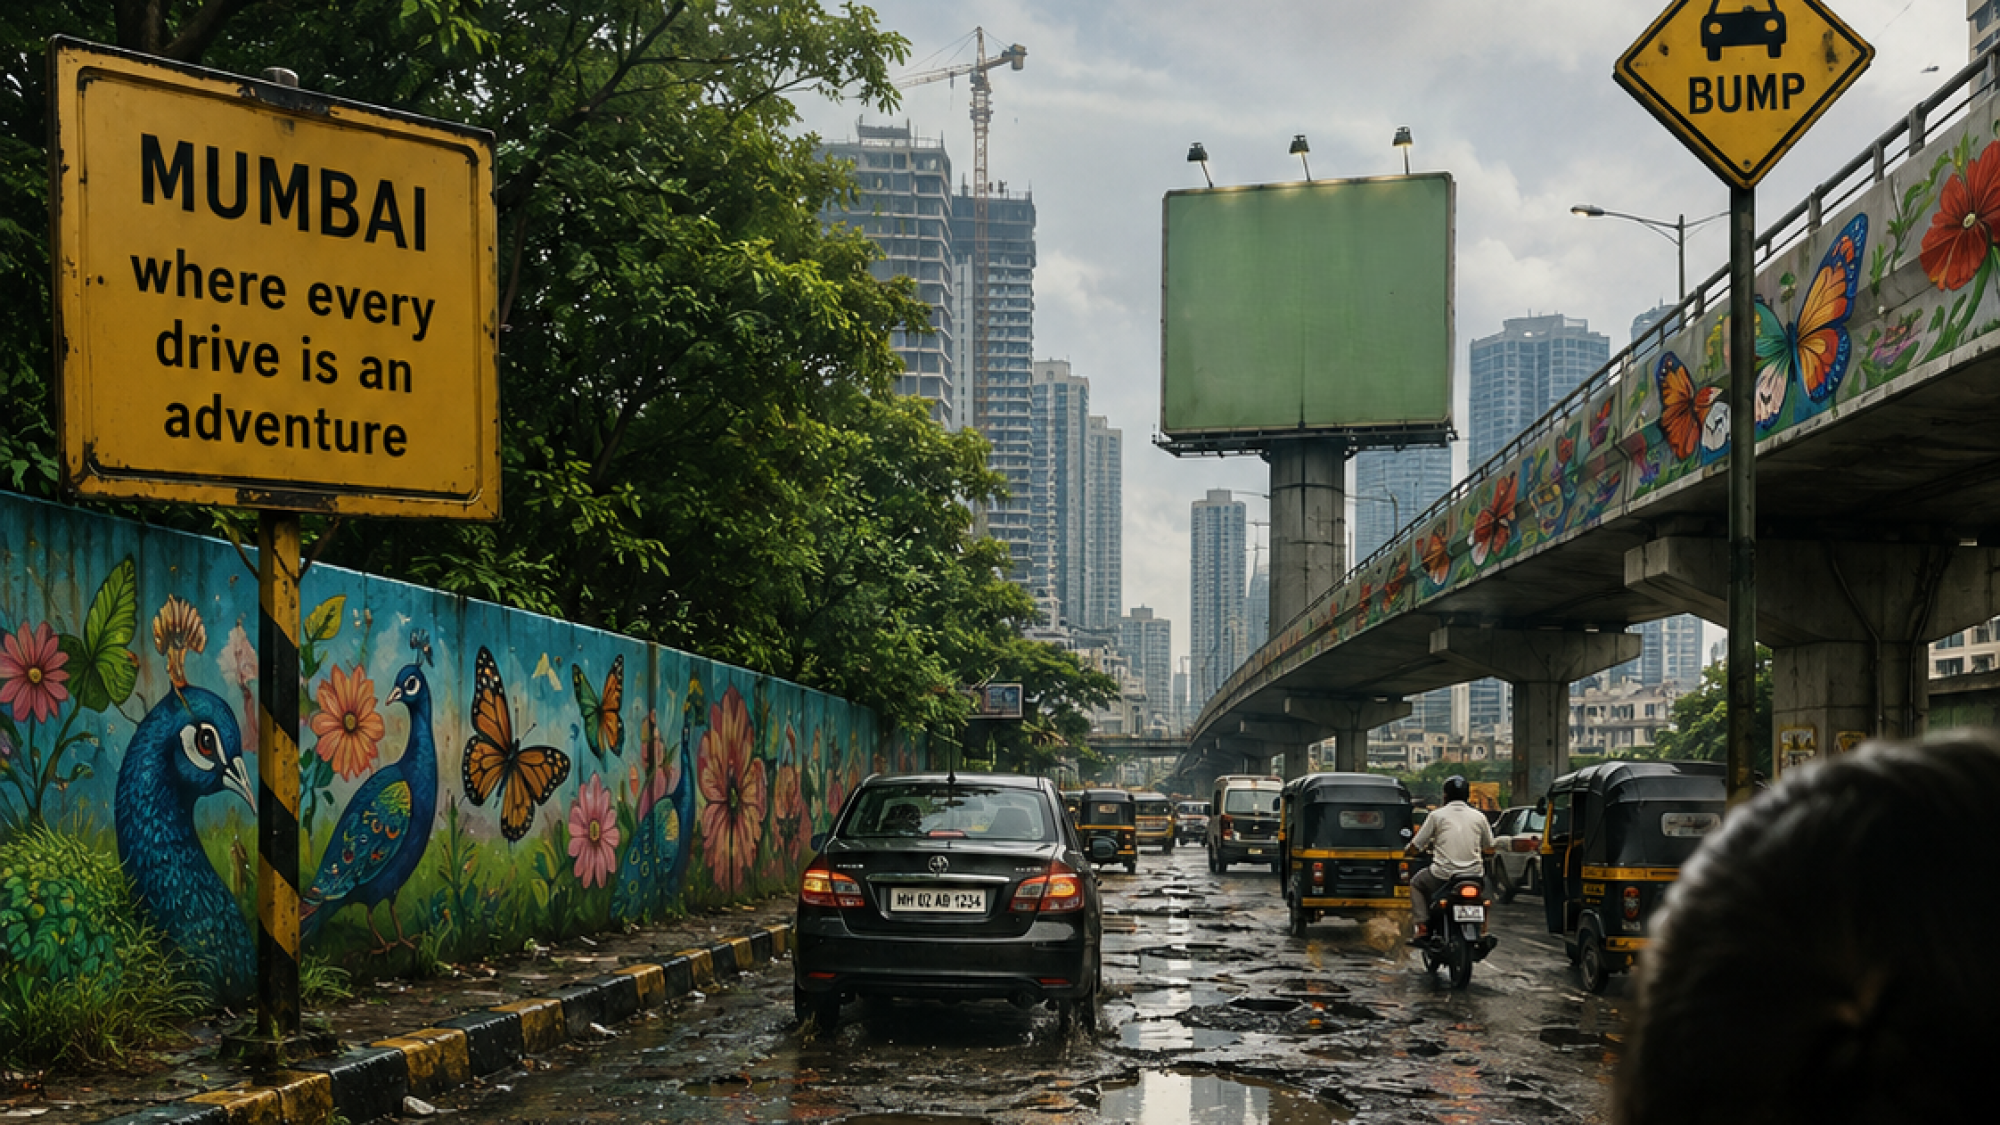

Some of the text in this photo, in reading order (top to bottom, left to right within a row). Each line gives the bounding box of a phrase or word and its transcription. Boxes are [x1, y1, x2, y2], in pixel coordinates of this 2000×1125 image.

[1689, 72, 1805, 115] BUMP
[141, 133, 427, 252] MUMBAI
[130, 249, 435, 341] where every
[156, 319, 412, 393] drive is an
[164, 394, 407, 457] adventure
[897, 893, 914, 907] MH
[955, 893, 981, 908] 1234
